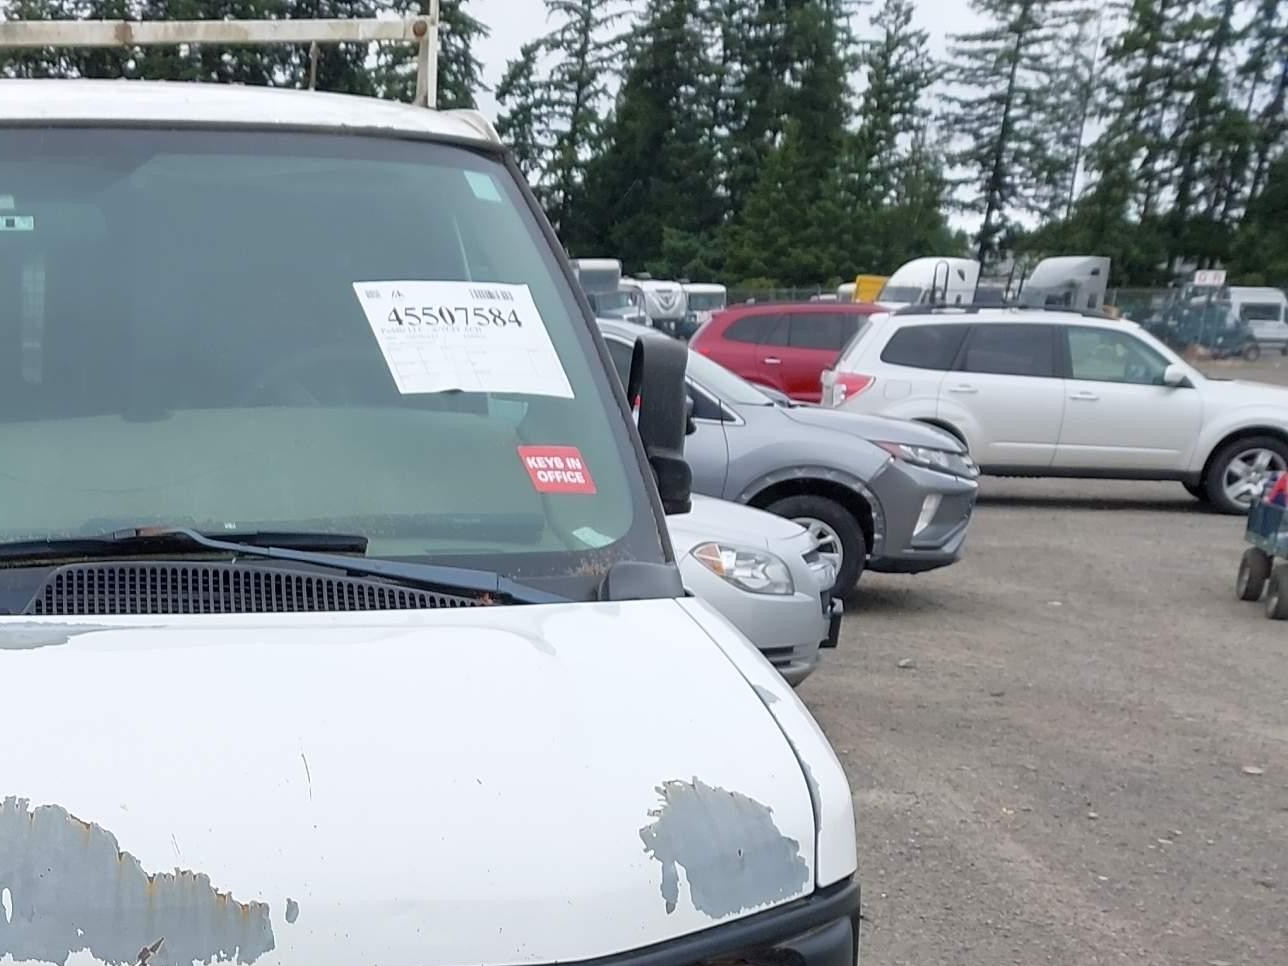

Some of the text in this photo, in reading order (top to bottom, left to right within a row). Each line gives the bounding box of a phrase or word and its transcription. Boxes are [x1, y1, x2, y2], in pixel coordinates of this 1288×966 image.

[387, 306, 523, 328] 45507584
[565, 457, 583, 470] IN
[536, 470, 586, 484] OFFICE
